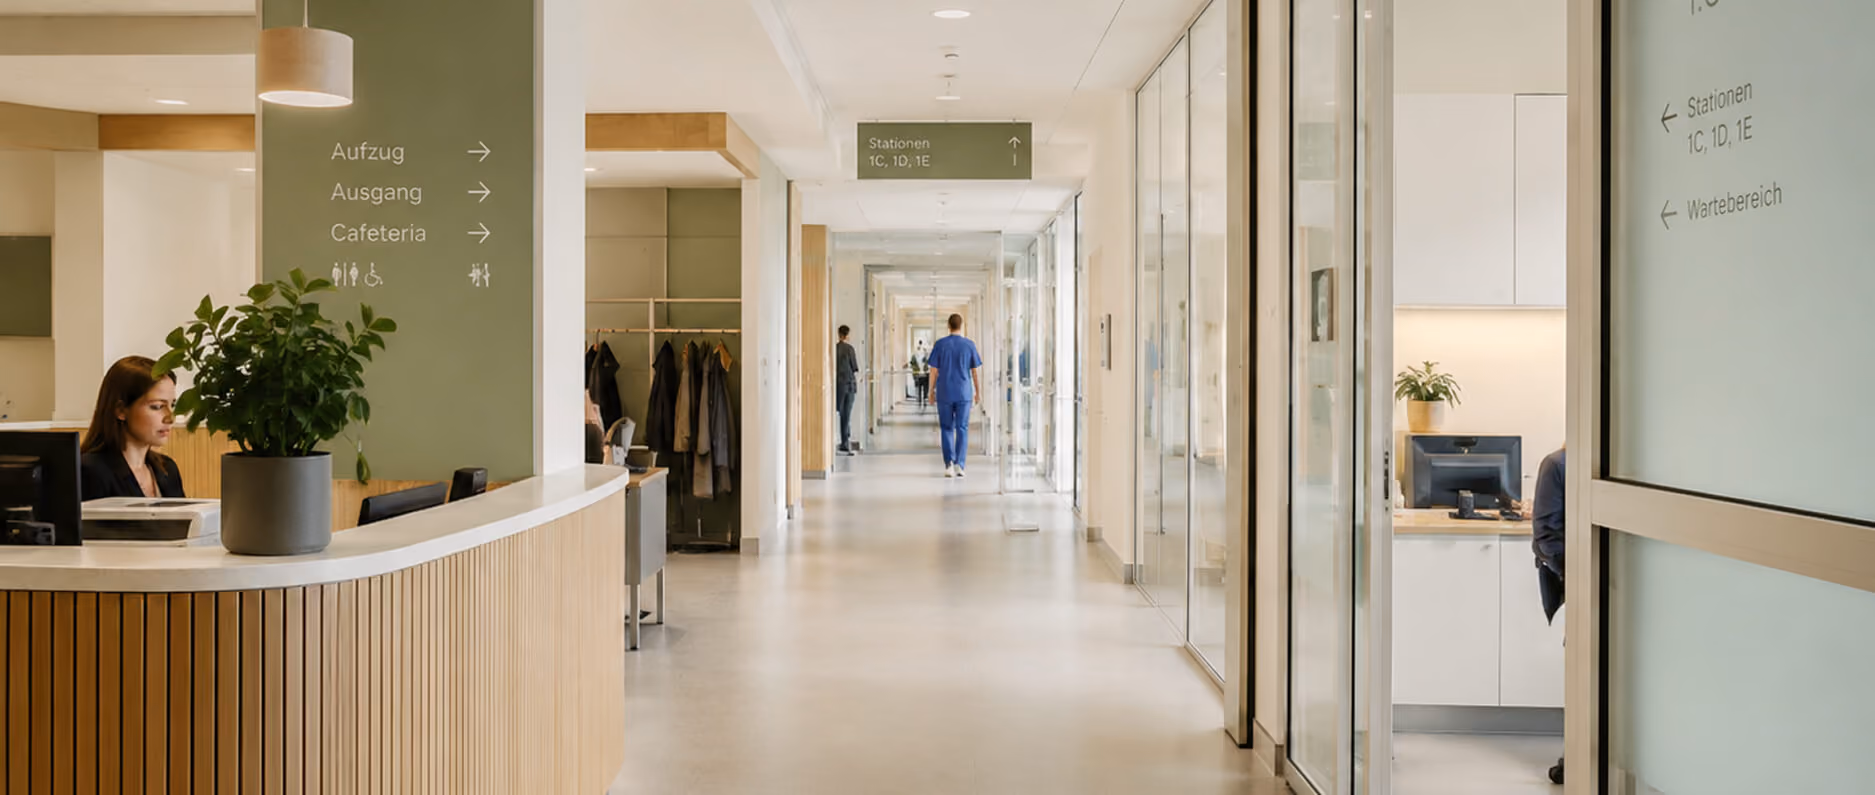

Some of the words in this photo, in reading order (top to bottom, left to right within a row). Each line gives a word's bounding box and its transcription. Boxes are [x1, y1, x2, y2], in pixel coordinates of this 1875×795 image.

[1687, 82, 1753, 119] Stationen
[868, 137, 931, 150] Stationen
[1687, 129, 1708, 155] 1C,
[1711, 123, 1732, 149] 1D,
[1736, 115, 1753, 142] 1E
[330, 141, 405, 165] Aufzug
[868, 154, 889, 169] 1C,
[893, 154, 912, 169] 1D,
[916, 154, 931, 168] 1E
[330, 182, 423, 206] Ausgang
[1687, 181, 1783, 221] Wartebereich
[330, 223, 427, 242] Cafeteria
